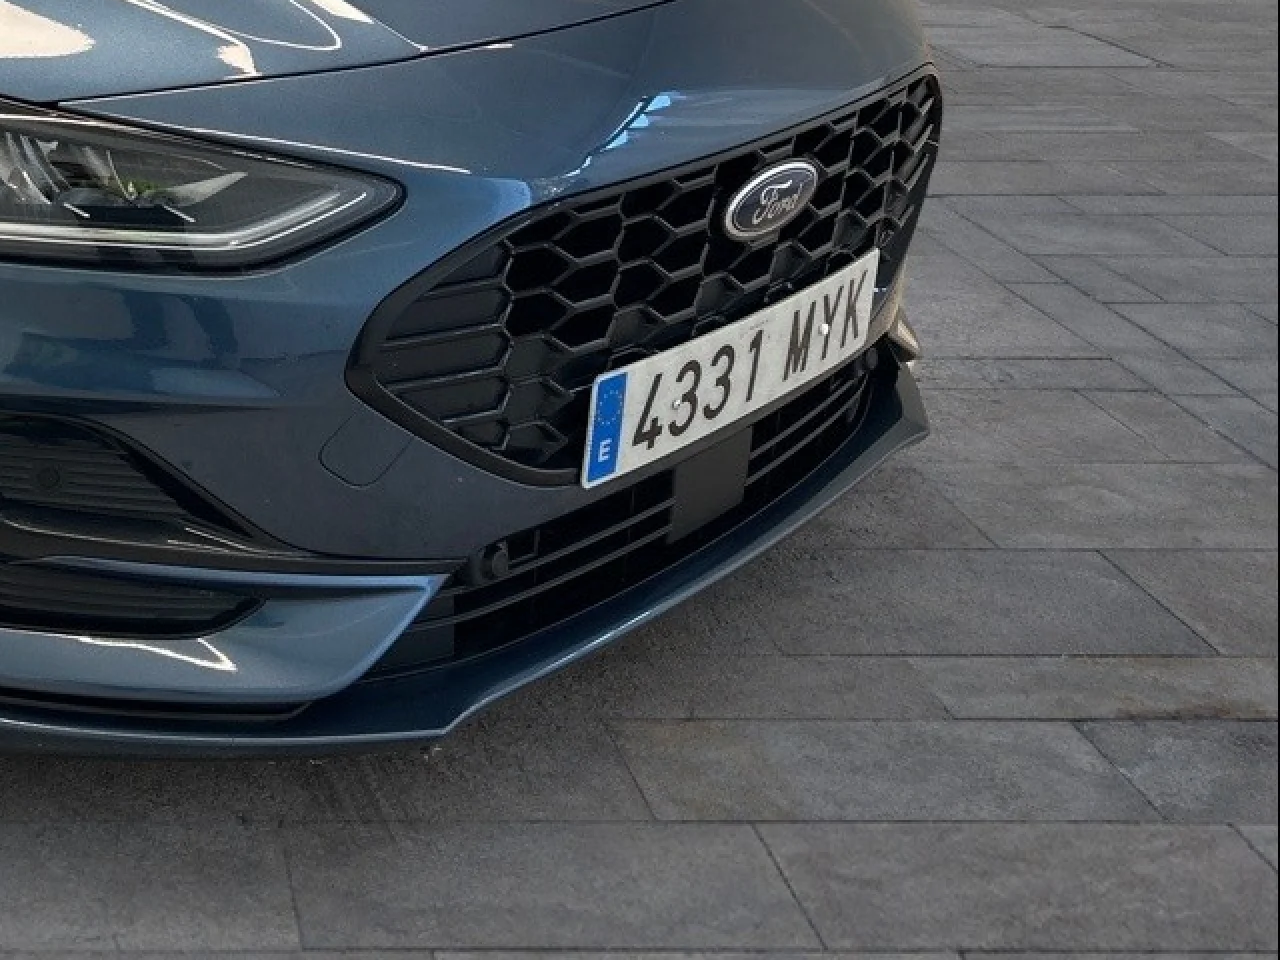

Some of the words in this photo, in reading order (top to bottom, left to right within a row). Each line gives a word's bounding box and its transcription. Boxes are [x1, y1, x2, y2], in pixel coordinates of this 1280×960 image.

[751, 179, 804, 225] Ford
[632, 329, 764, 450] 4331
[782, 269, 869, 383] MYK
[597, 439, 613, 462] E
